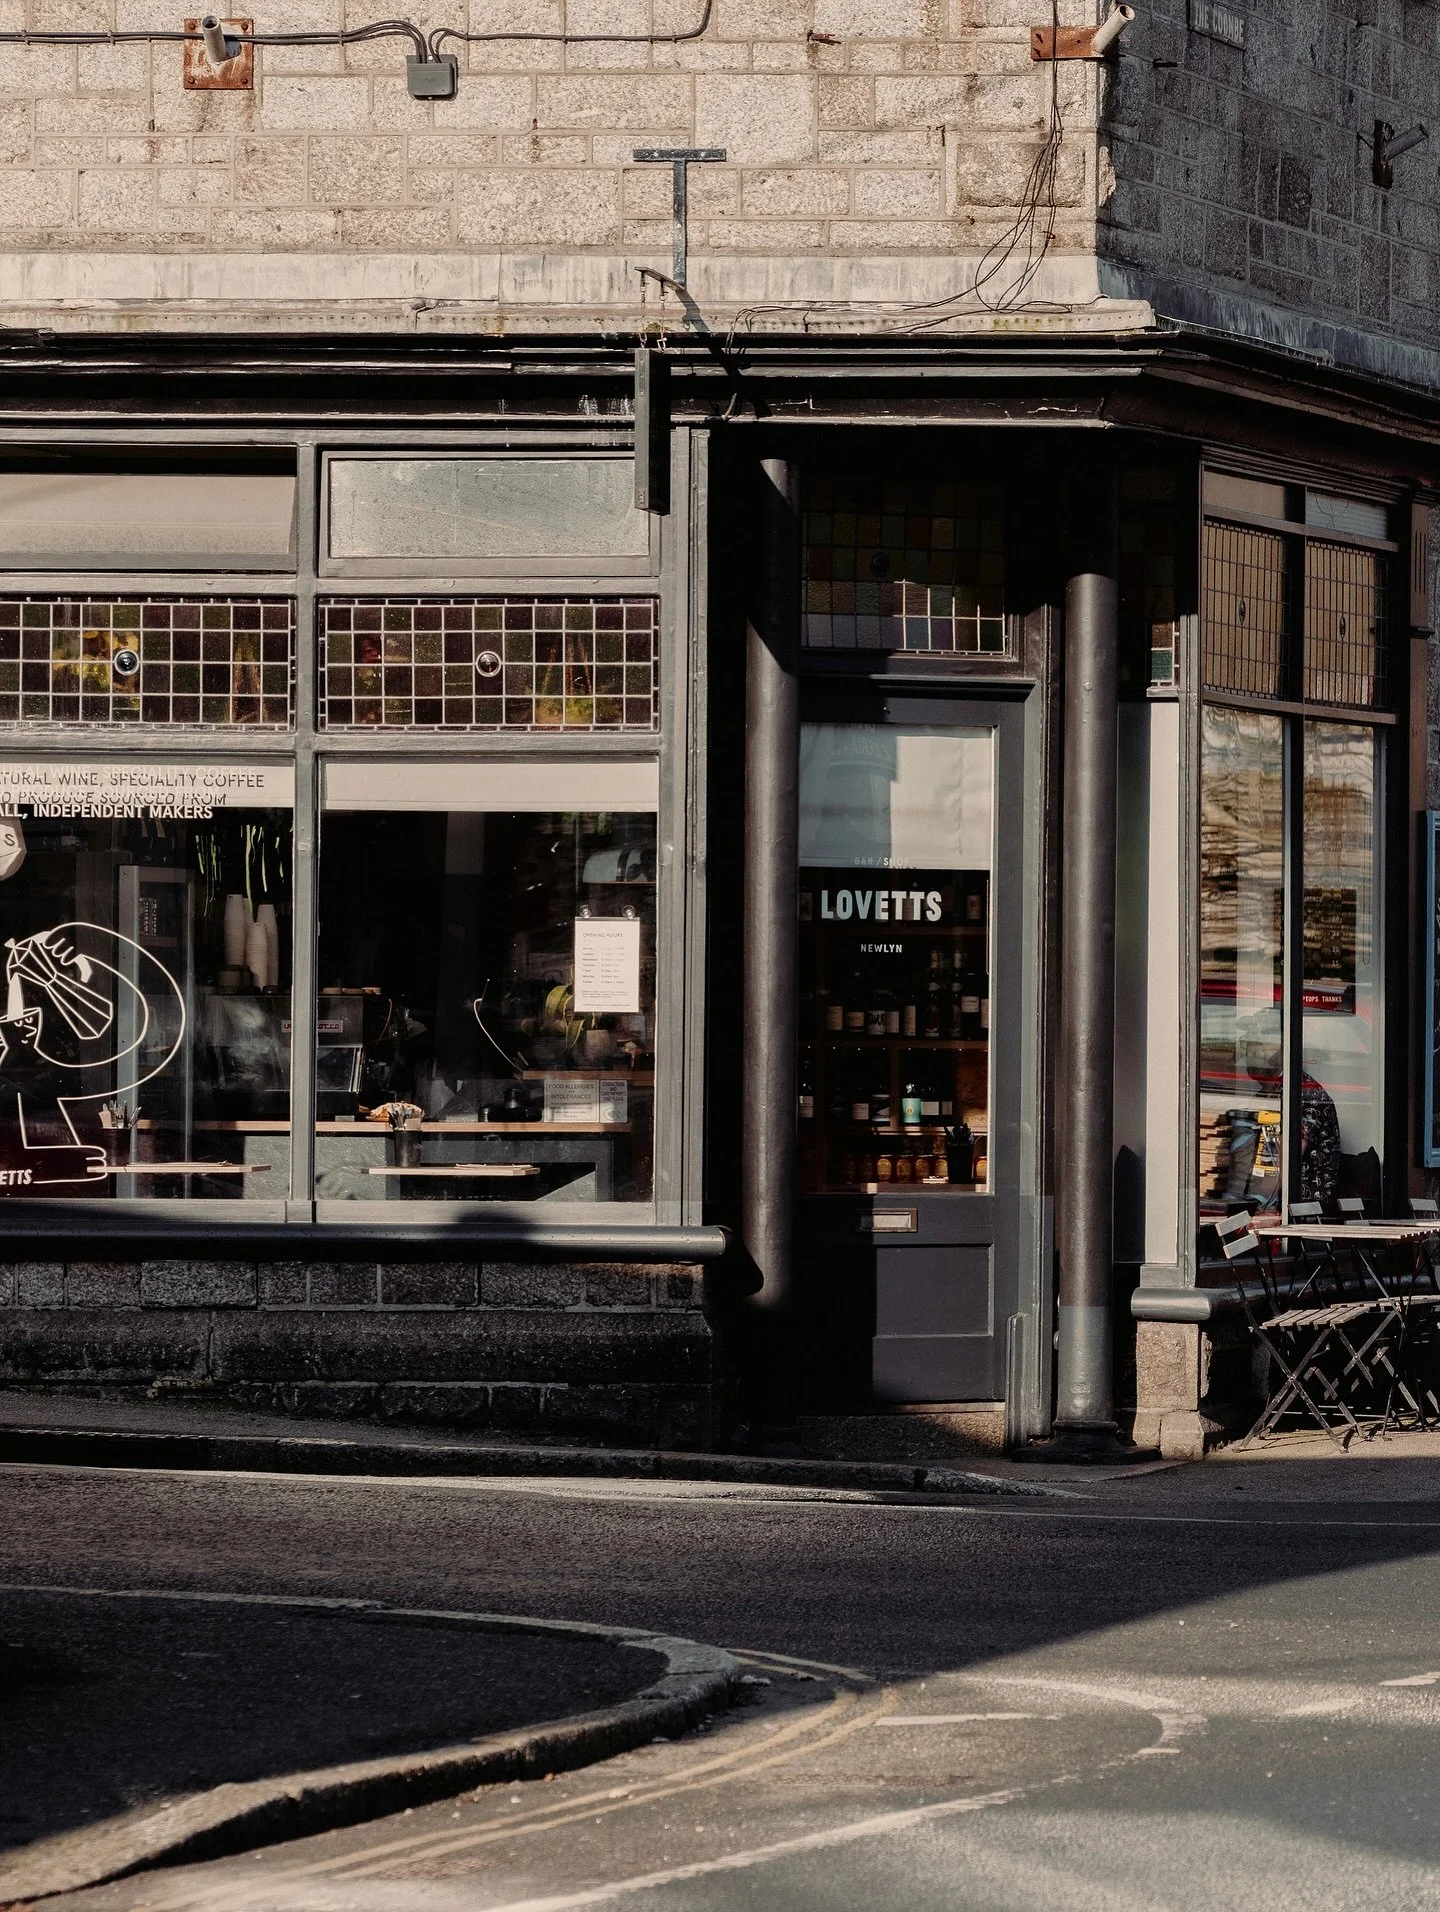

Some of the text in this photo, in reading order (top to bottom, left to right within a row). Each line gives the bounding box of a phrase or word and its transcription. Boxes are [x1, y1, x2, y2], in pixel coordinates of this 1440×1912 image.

[0, 772, 265, 788] TURAL WINE, SPECIALITY COFFEE
[19, 792, 95, 804] PRODUCE
[100, 792, 176, 805] SOURCED
[181, 793, 227, 806] FROM
[33, 804, 146, 819] INDEPENDENT
[149, 805, 213, 819] MAKERS
[854, 856, 873, 866] BAR
[883, 856, 910, 866] SHOP
[820, 889, 942, 922] LOVETTS
[860, 943, 902, 953] NEWLYN
